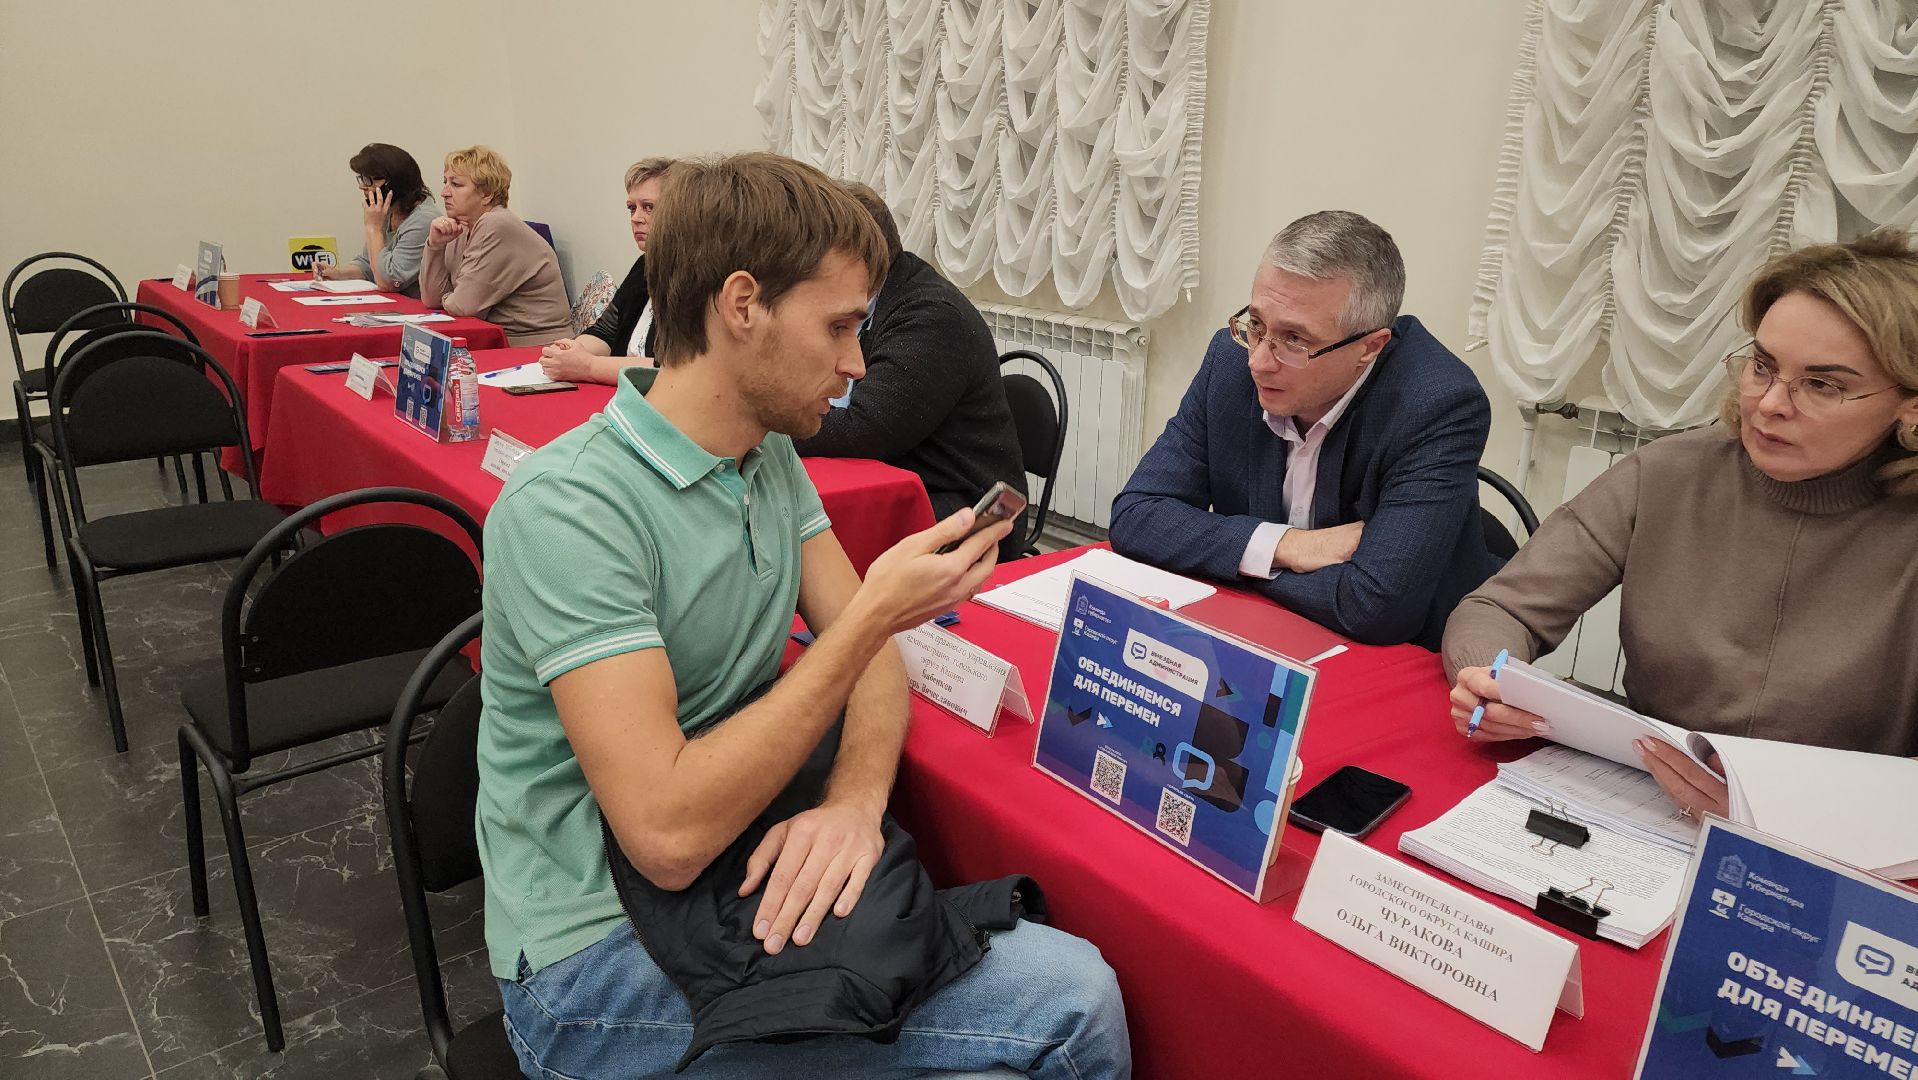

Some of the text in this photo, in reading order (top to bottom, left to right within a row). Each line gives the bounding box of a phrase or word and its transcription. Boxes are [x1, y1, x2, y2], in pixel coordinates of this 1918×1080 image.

[1148, 659, 1199, 685] АДМИНИСТРАЦИЯ
[1150, 650, 1182, 668] ВЫЕЗДНАЯ
[921, 668, 953, 693] Бабенков
[921, 683, 968, 716] Вячеславович
[1073, 673, 1161, 728] ДЛЯ ПЕРЕМЕН
[1078, 656, 1182, 717] ОБЪЕДИНЯЕМСЯ
[1745, 881, 1804, 909] губернатора
[1747, 871, 1789, 893] Команда
[1349, 874, 1513, 963] ГОРОДСКОГО ОКРУГА КАШИРА
[1375, 871, 1495, 935] ЗАМЕСТИТЕЛЬ ГЛАВЫ
[1737, 911, 1775, 933] Кашира
[1739, 903, 1821, 943] Городской округ
[1380, 906, 1463, 960] ЧУРАКОВА
[1336, 908, 1498, 1002] ОЛЬГА ВИКТОРОВНА
[1716, 978, 1783, 1021] ДЛЯ
